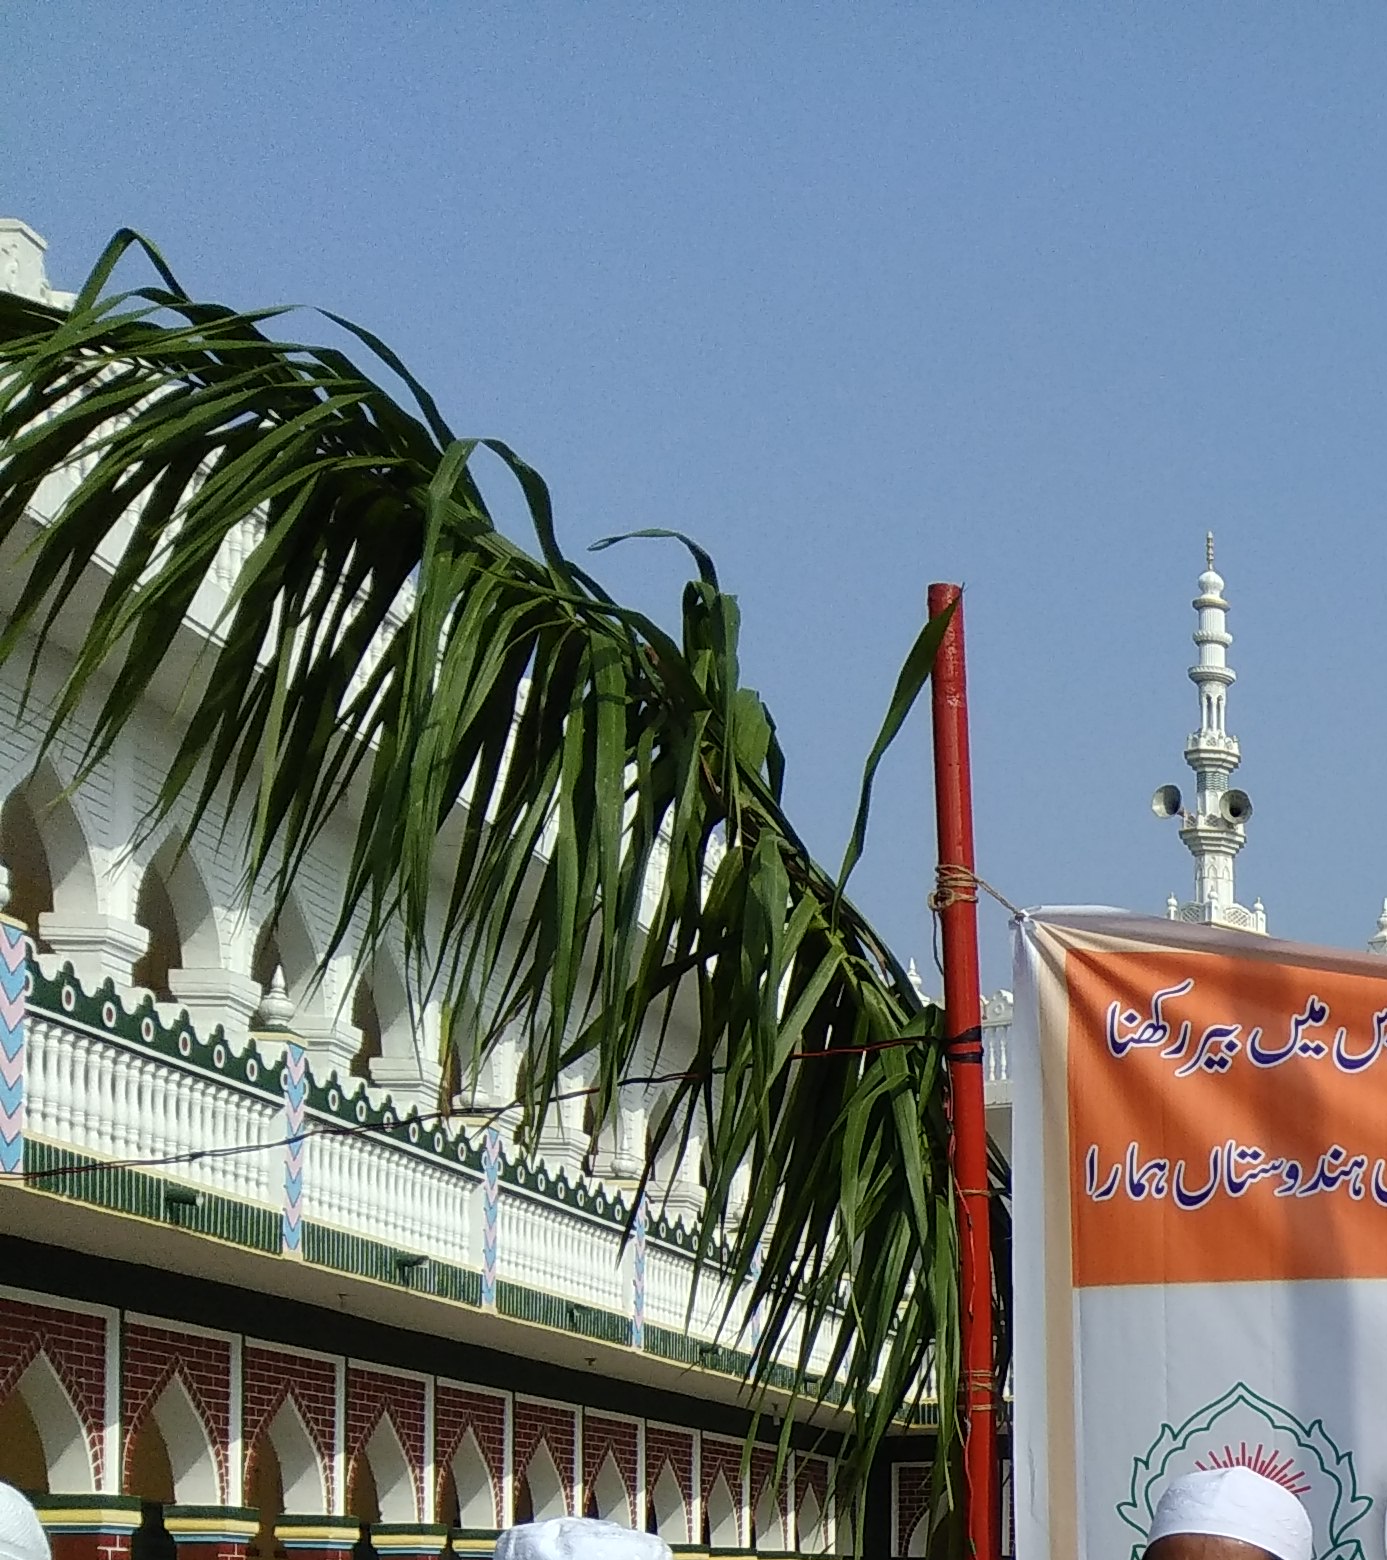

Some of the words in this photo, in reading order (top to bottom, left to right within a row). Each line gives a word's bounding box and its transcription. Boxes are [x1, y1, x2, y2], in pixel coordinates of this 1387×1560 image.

[1107, 978, 1194, 1058] رکھنا
[1175, 1023, 1242, 1077] بیر
[1247, 994, 1330, 1068] میں
[1086, 1141, 1170, 1202] ہمارا
[1172, 1138, 1368, 1211] ہندوستاں
